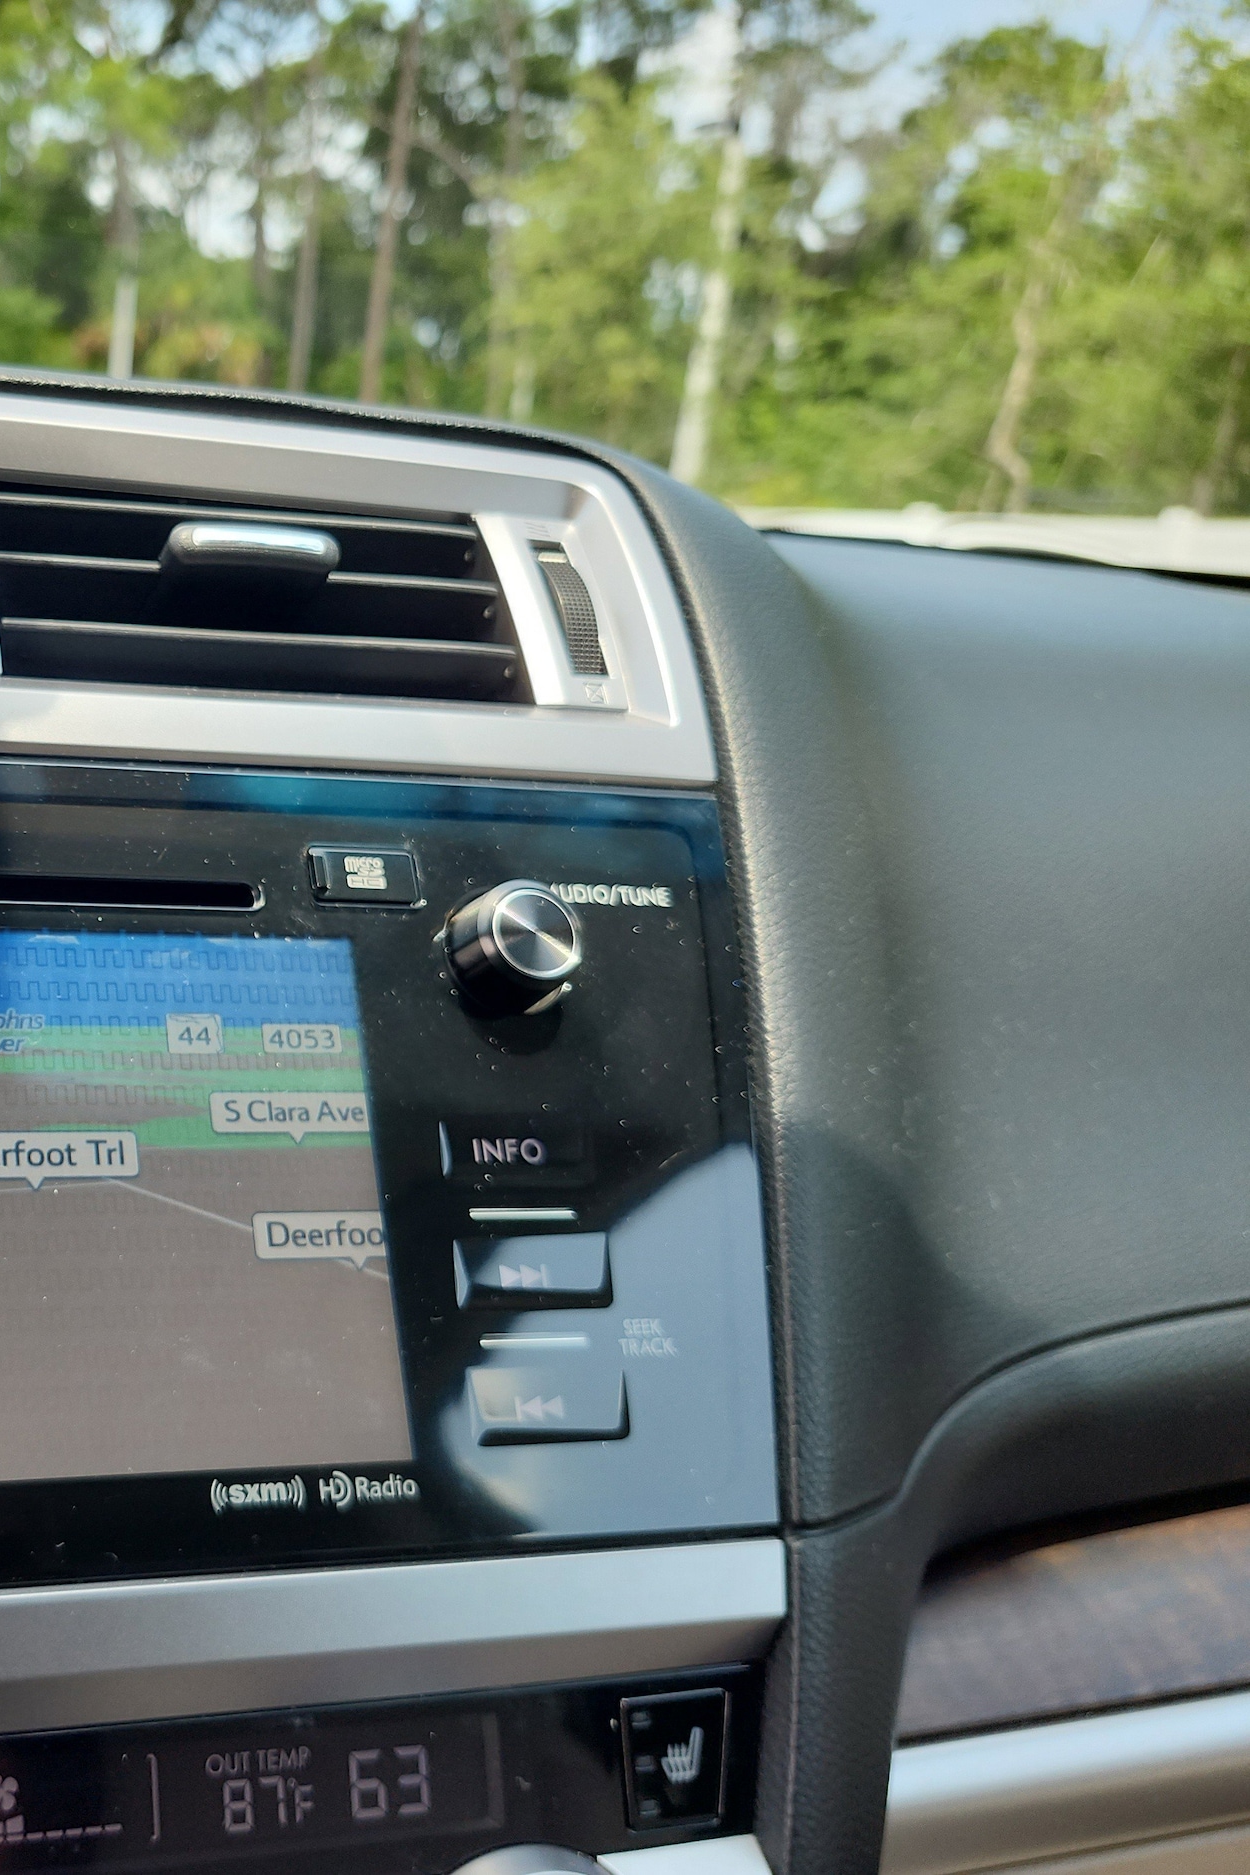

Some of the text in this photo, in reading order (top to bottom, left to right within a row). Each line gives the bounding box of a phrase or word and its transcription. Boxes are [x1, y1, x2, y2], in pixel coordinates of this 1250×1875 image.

[178, 1027, 211, 1045] 44
[268, 1029, 336, 1049] 4053
[224, 1100, 364, 1122] S Clara Ave
[85, 1140, 124, 1167] Trl
[472, 1137, 546, 1165] INFO
[623, 1318, 662, 1337] SEEK
[618, 1337, 677, 1357] TRACK
[355, 1473, 419, 1502] Radio
[206, 1746, 312, 1778] OUT TEMP
[349, 1745, 430, 1817] 63
